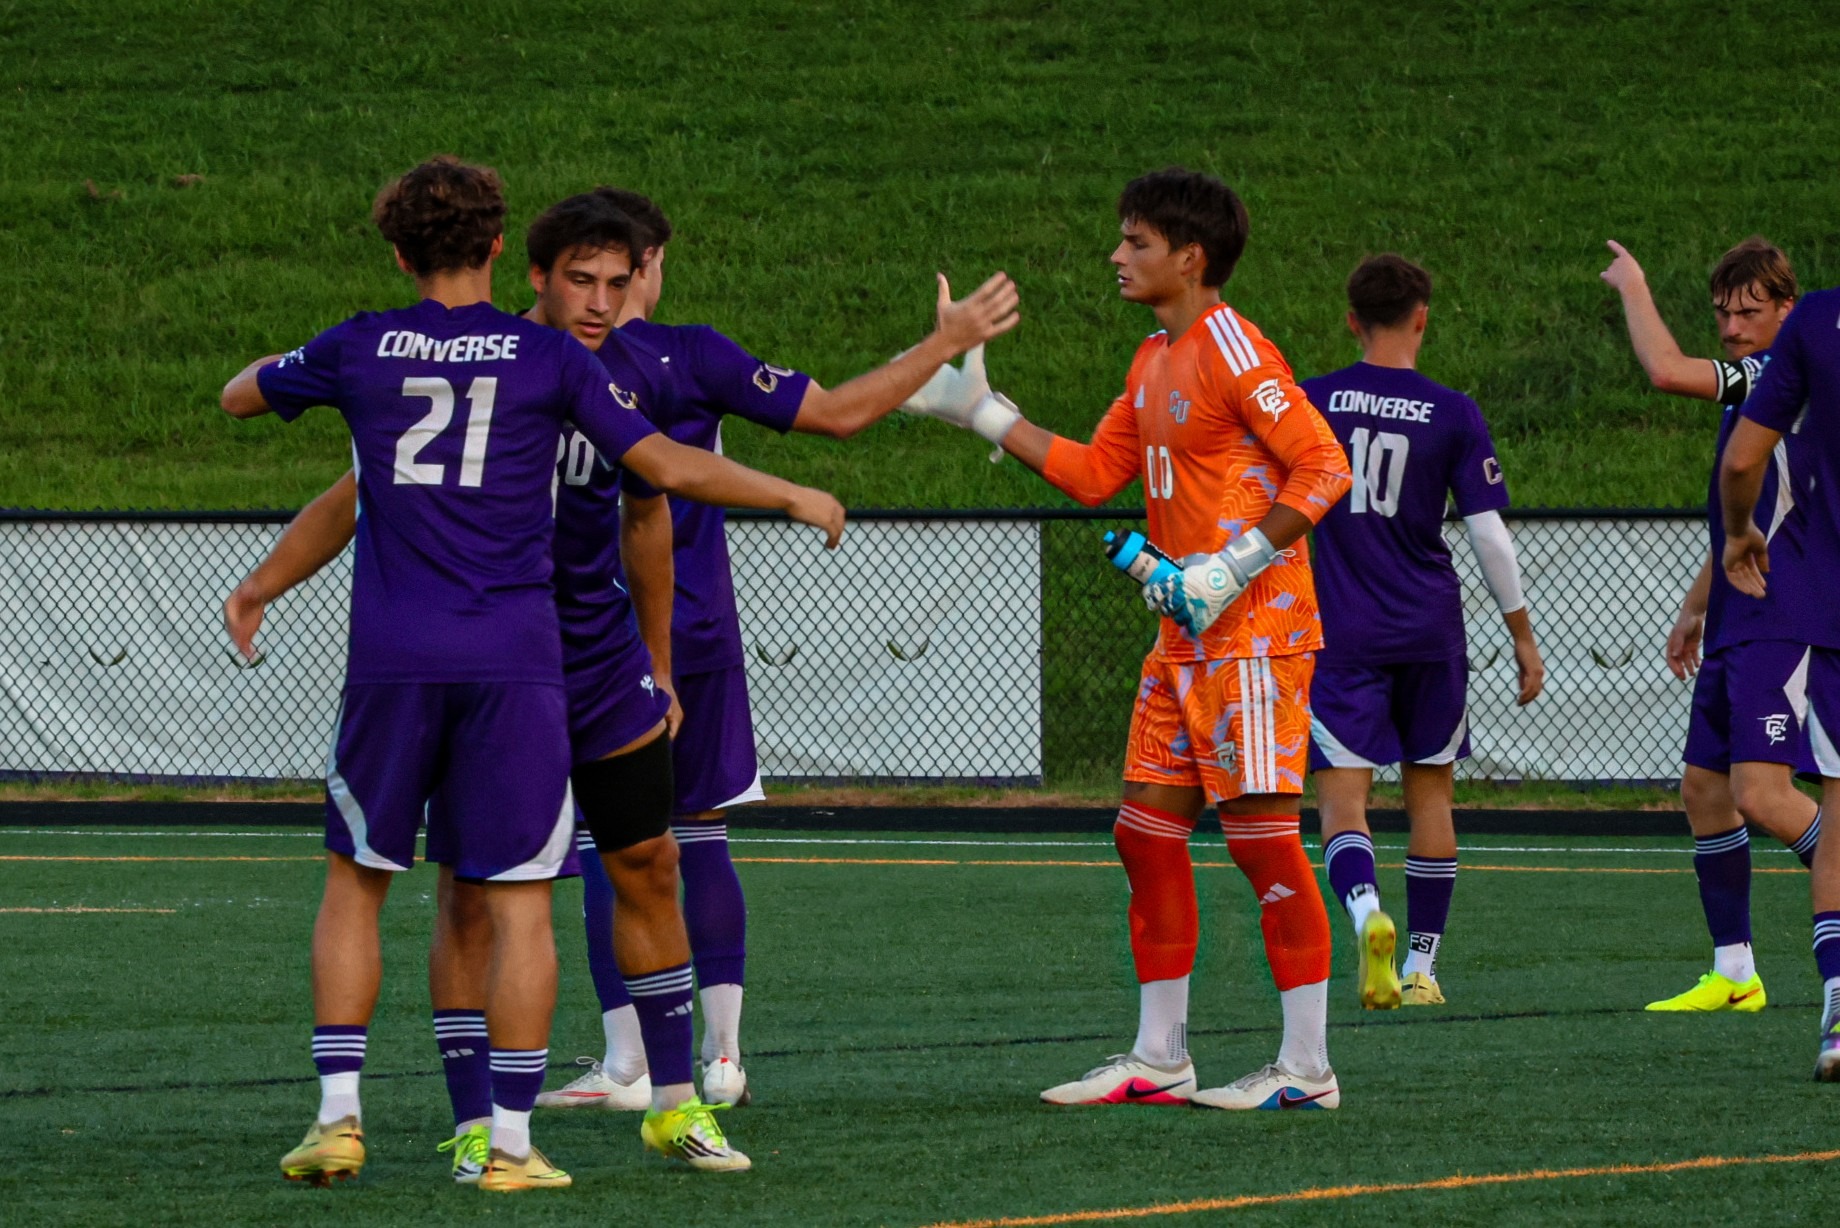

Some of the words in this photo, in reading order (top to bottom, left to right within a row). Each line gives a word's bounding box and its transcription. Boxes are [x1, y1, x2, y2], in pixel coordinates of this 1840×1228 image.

[377, 331, 520, 362] CONVERSE
[1169, 389, 1191, 424] CU
[1328, 390, 1435, 423] CONVERSE
[393, 376, 498, 488] 21
[1348, 427, 1410, 518] 10
[1410, 933, 1433, 953] FS
